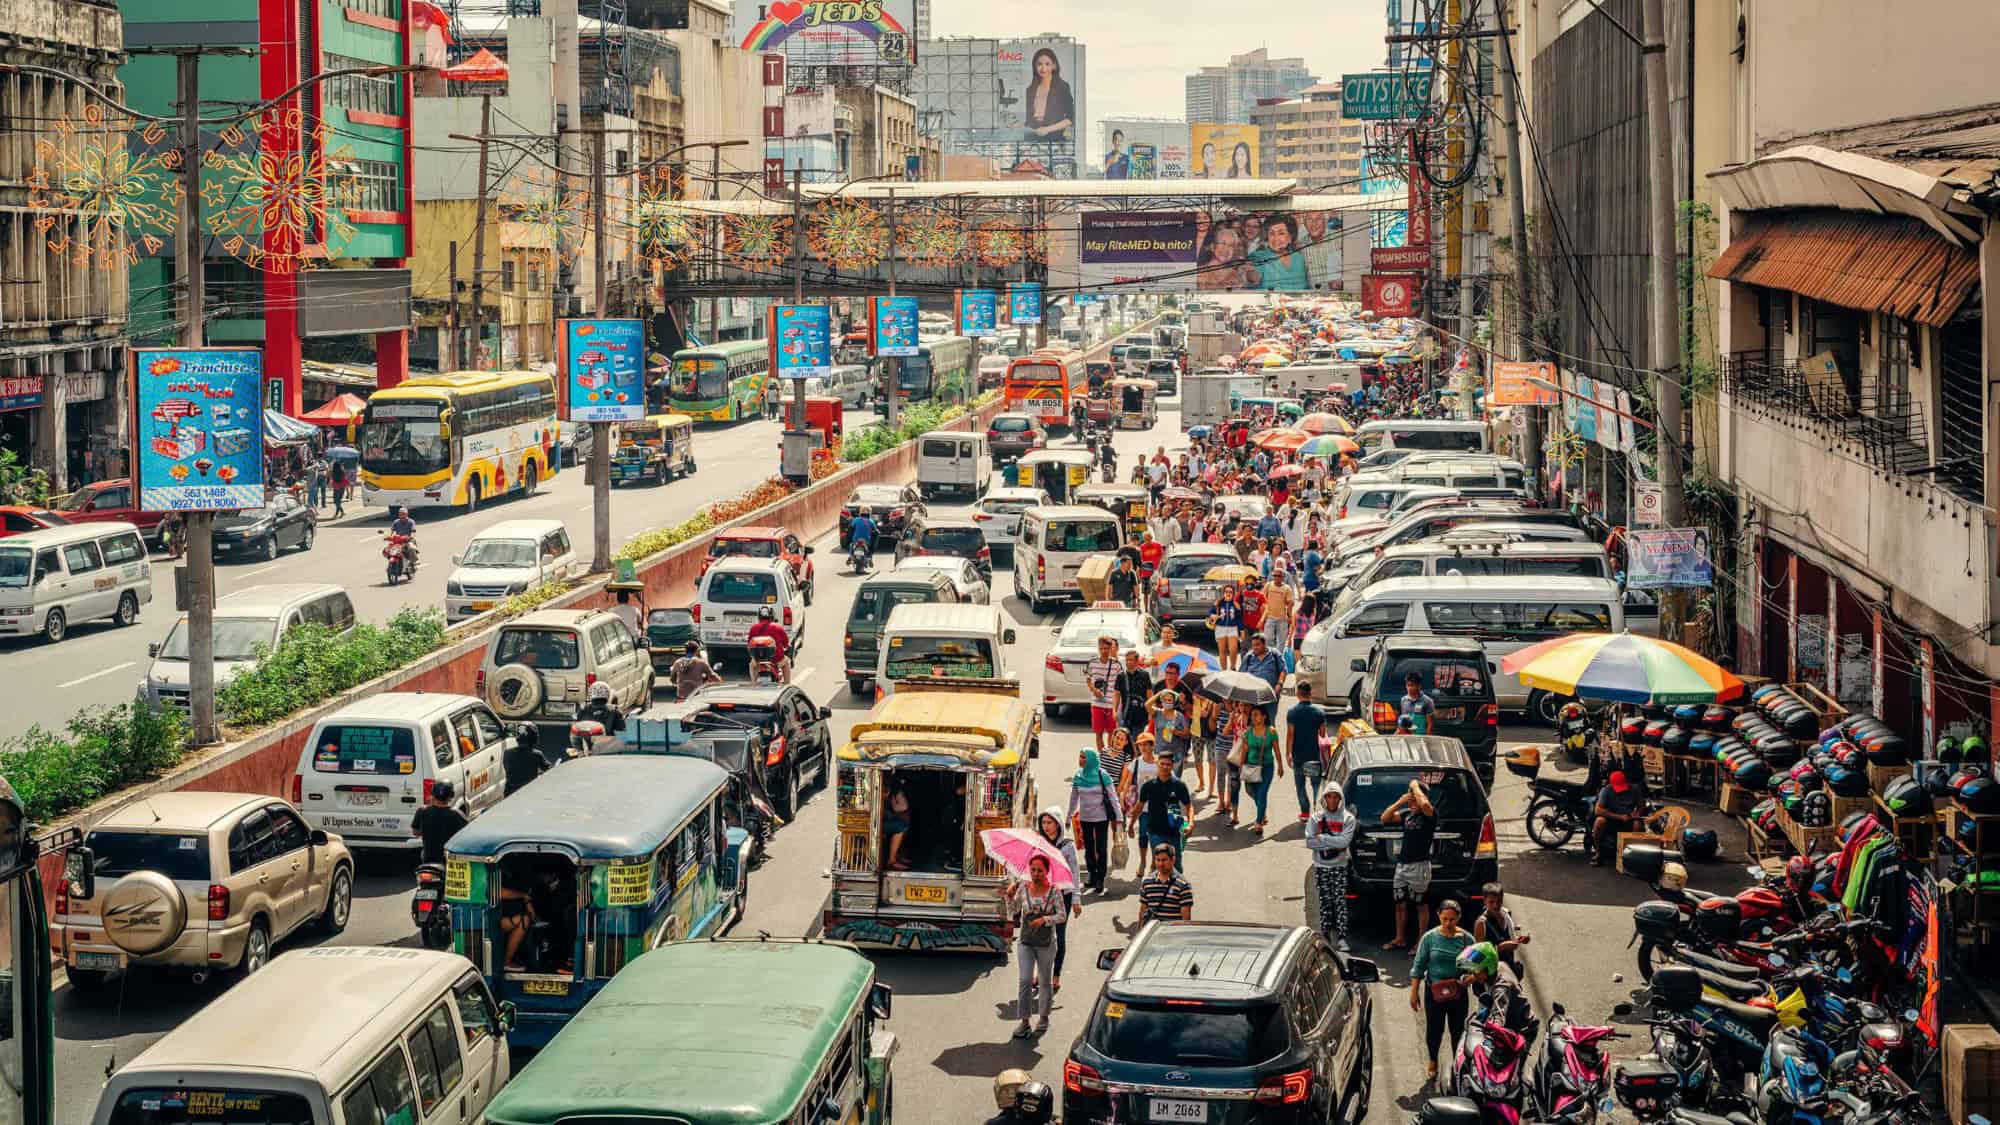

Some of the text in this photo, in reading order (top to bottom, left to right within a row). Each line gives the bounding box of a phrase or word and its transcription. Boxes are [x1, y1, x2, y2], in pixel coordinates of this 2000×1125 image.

[758, 0, 882, 27] I JED'S
[885, 39, 904, 49] 24
[1347, 104, 1372, 113] HOTEL
[1086, 240, 1192, 252] May RiteMED ba nito?
[1374, 252, 1430, 266] PAWNSHOP
[322, 816, 331, 826] UV
[332, 816, 353, 828] Express
[354, 817, 374, 827] Service
[1723, 1020, 1766, 1050] SUZU
[1174, 1103, 1201, 1117] 2063
